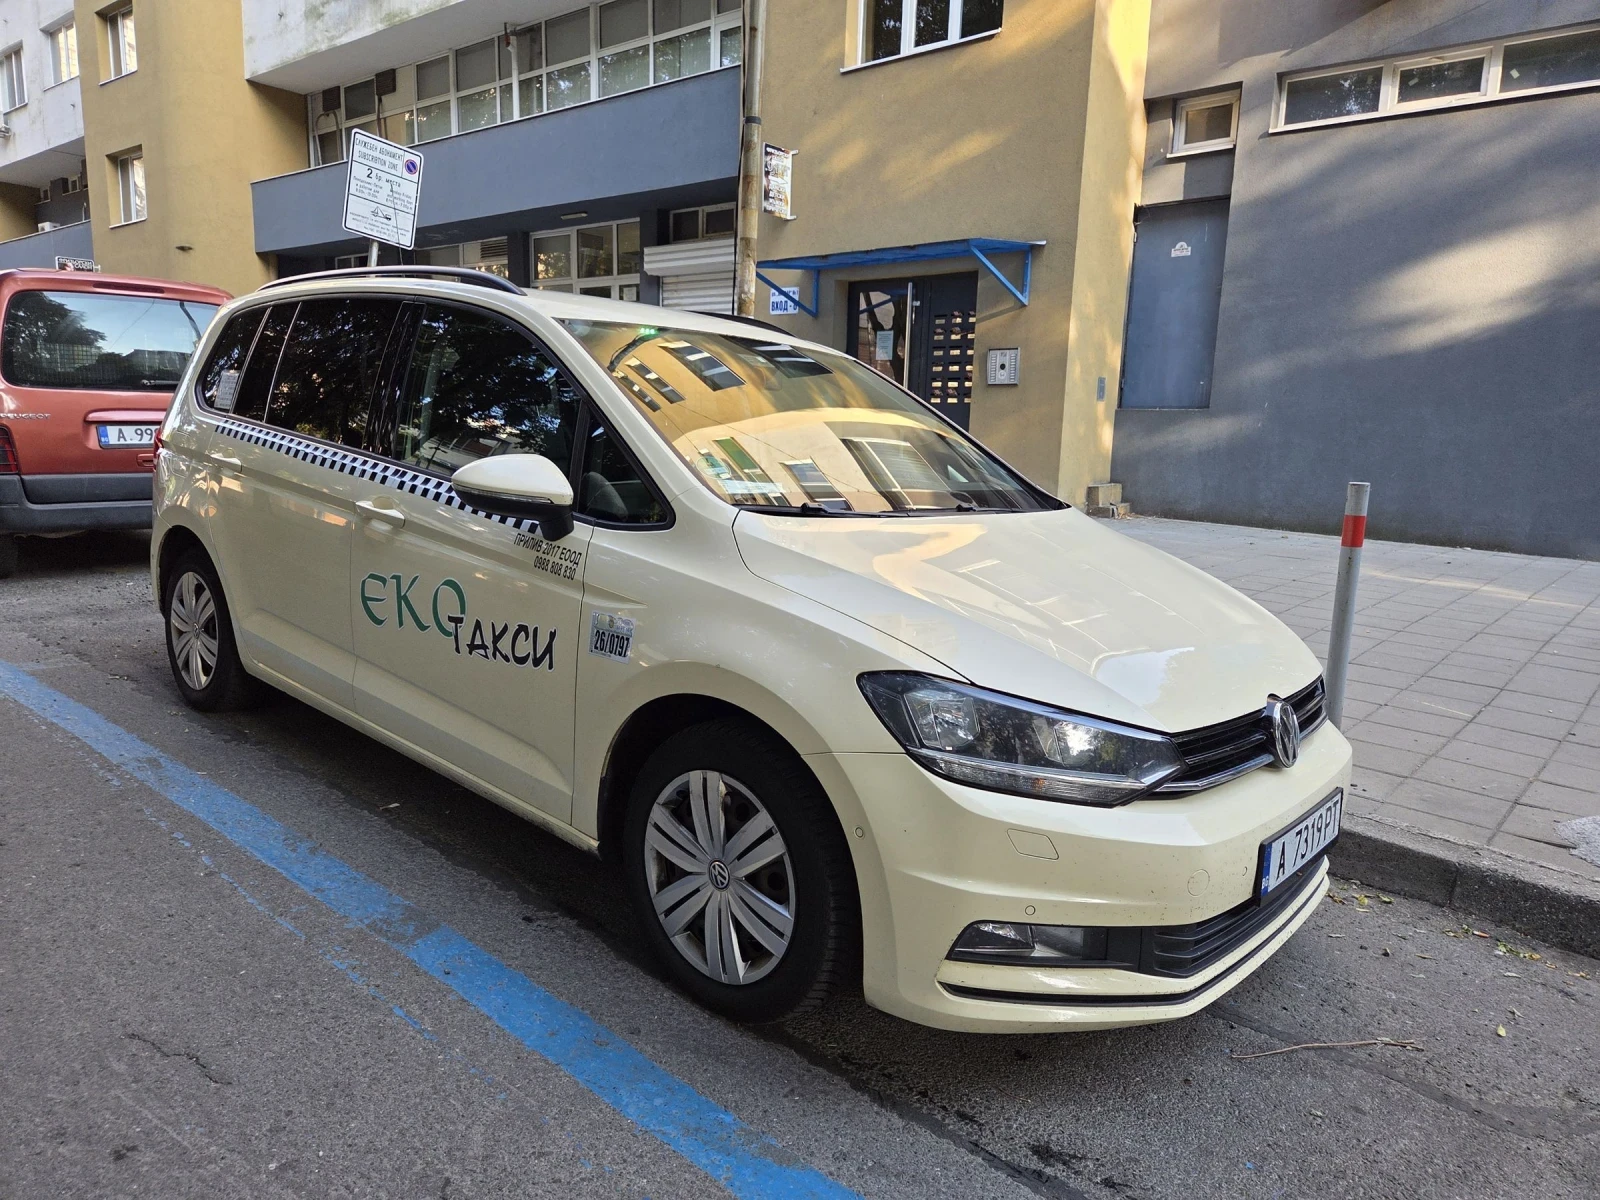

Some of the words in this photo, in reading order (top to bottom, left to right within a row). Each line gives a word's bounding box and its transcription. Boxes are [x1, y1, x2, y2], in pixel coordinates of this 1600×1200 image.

[366, 168, 373, 179] 2
[387, 161, 399, 172] ZONE
[771, 300, 788, 313] ВХОД
[514, 533, 543, 553] ПРИЛИВ
[542, 542, 561, 558] 2017
[559, 547, 582, 568] ЕООД
[549, 561, 563, 577] 808
[562, 565, 577, 581] 830
[360, 572, 467, 638] ЕКО
[447, 615, 557, 671] ТАКСИ
[594, 630, 630, 657] 26/0797
[1276, 841, 1285, 881] A
